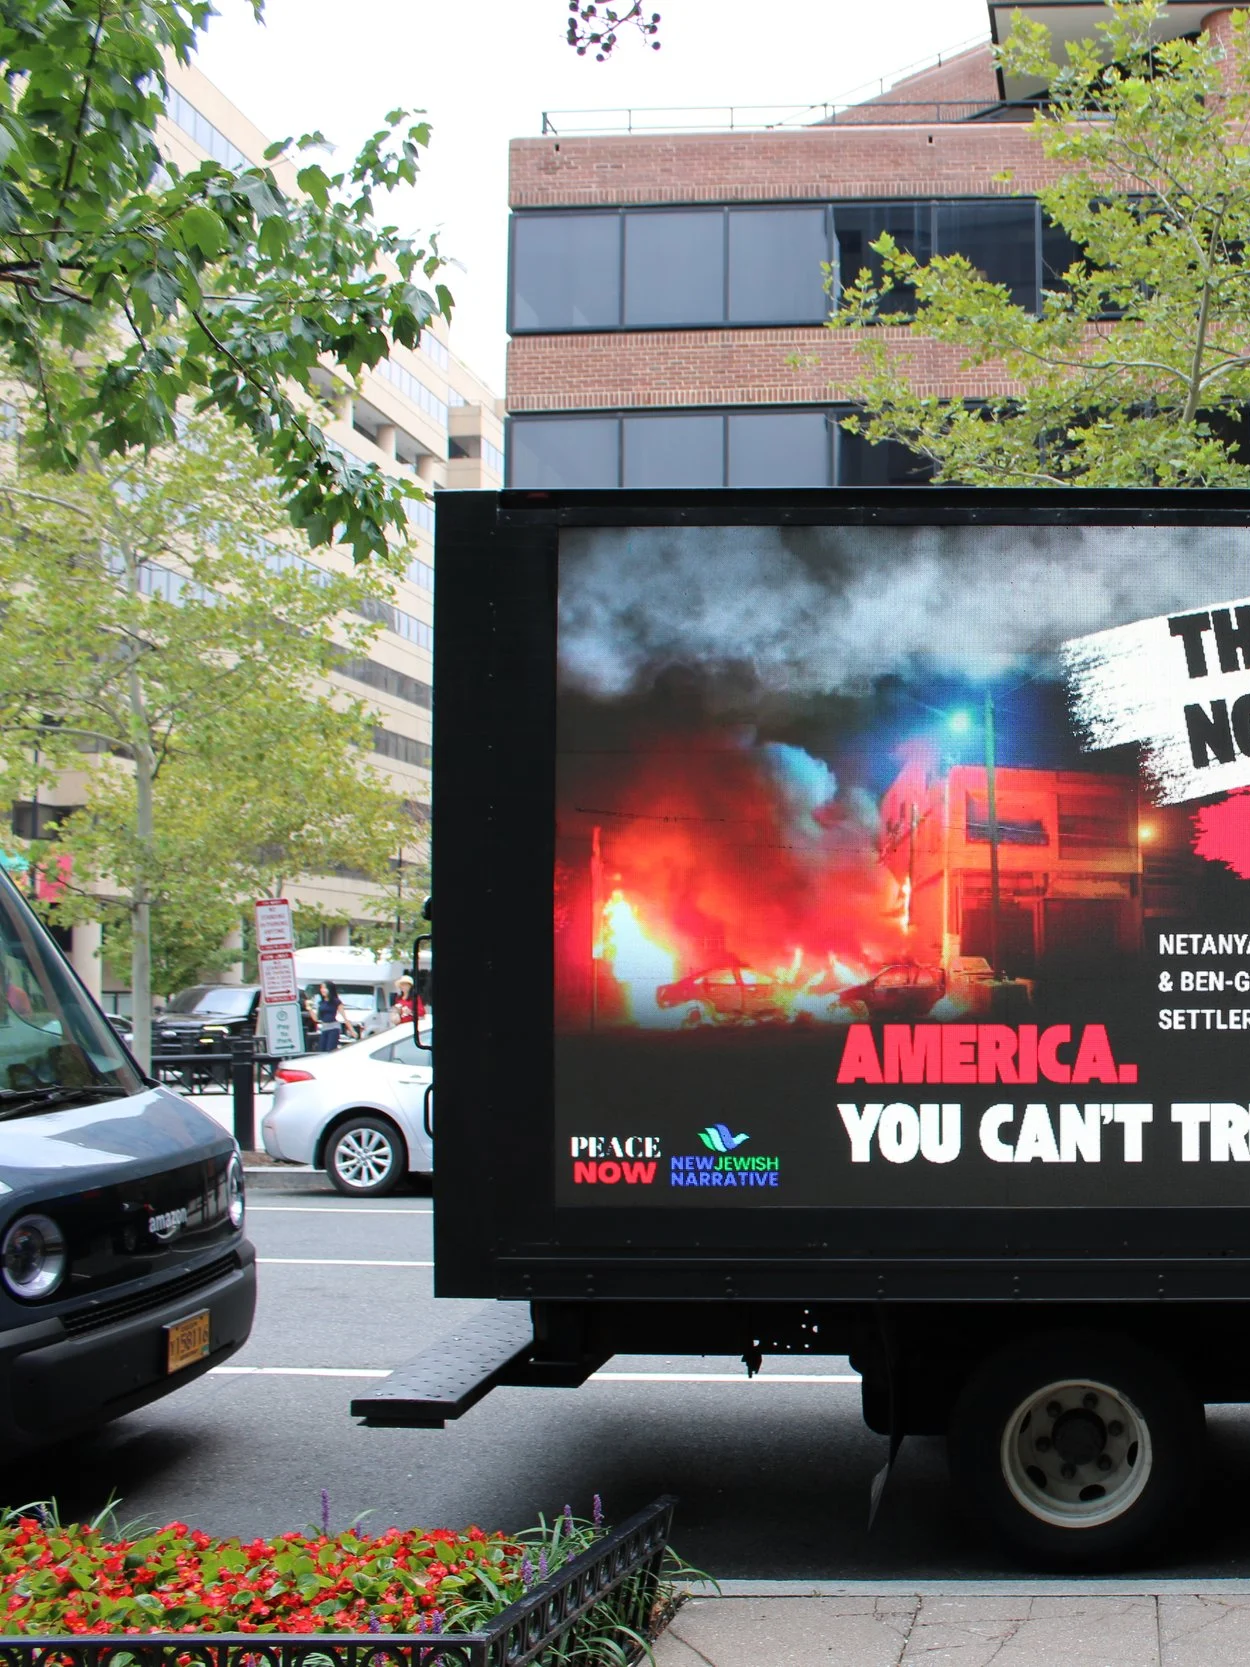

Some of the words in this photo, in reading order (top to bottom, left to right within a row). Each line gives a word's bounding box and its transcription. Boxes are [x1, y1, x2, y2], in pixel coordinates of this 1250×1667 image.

[1158, 971, 1173, 992] &
[836, 1024, 1138, 1084] AMERICA.
[837, 1103, 961, 1163] YOU
[979, 1103, 1153, 1163] CAN'T
[571, 1136, 661, 1158] PEACE
[574, 1161, 657, 1184] NOW
[671, 1172, 779, 1187] NARRATIVE
[149, 1208, 188, 1233] amazon
